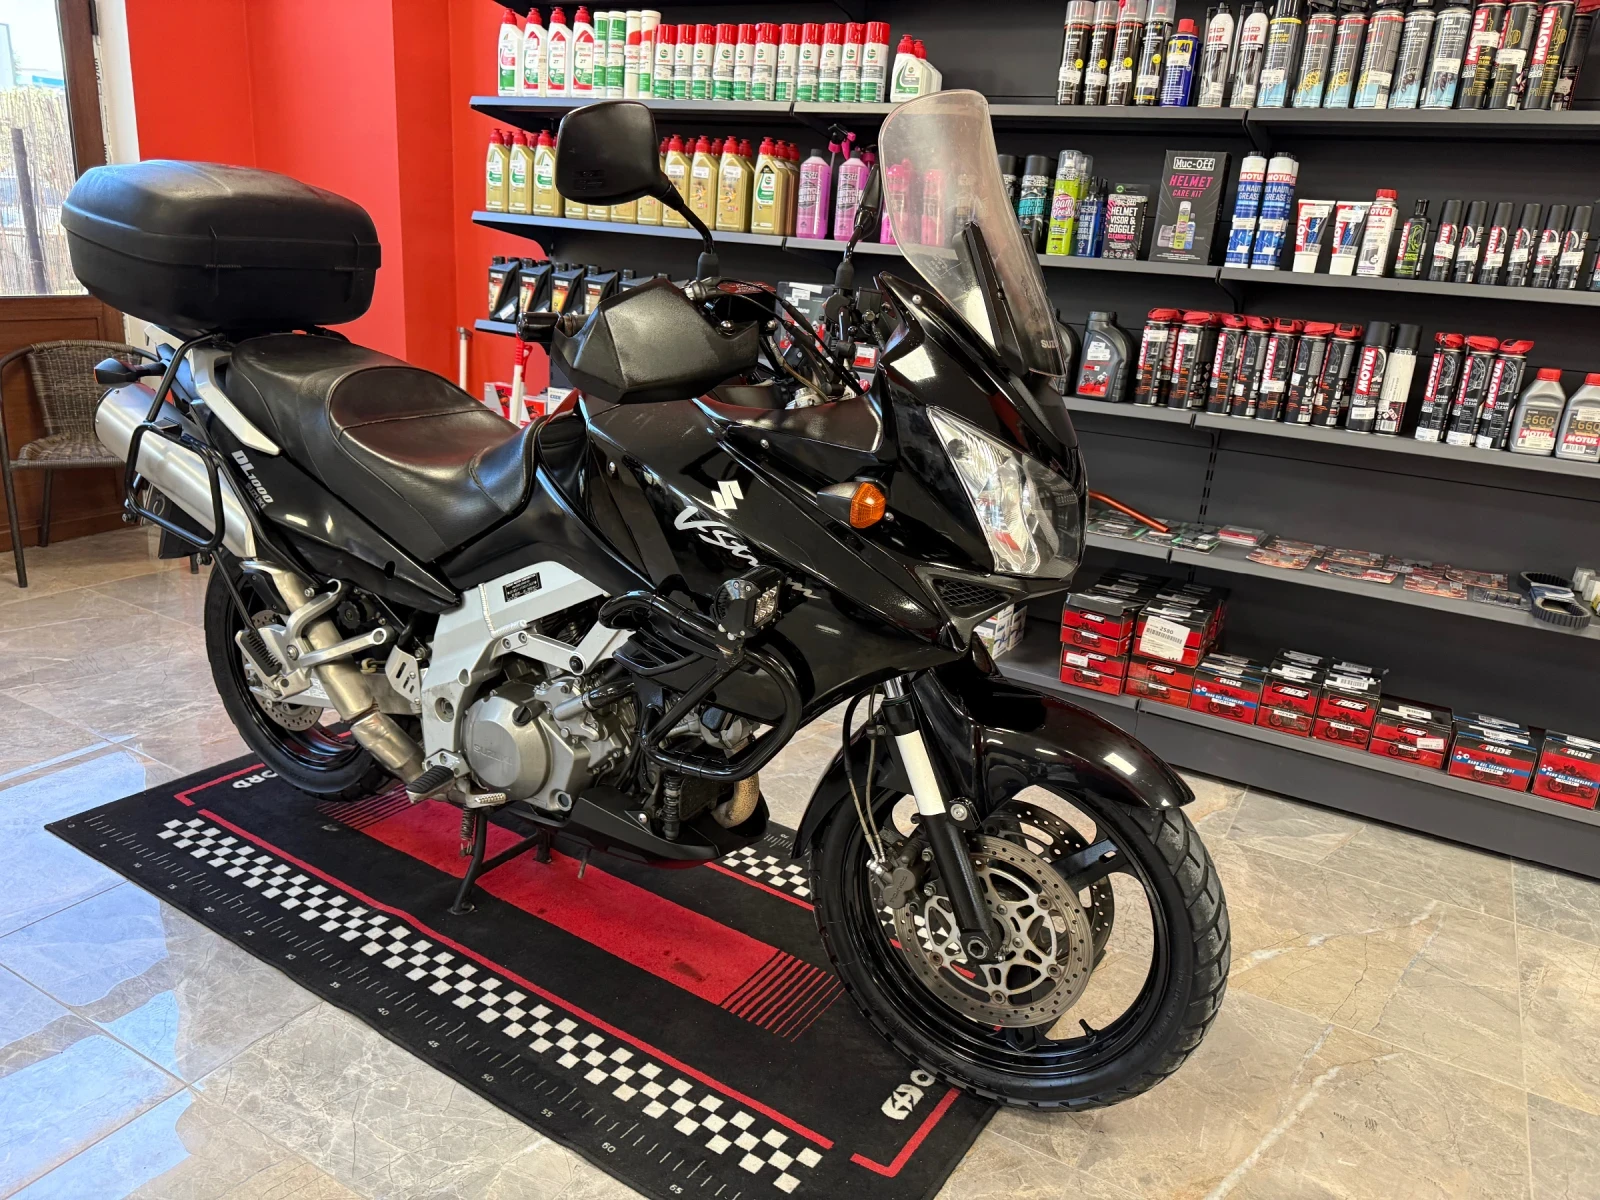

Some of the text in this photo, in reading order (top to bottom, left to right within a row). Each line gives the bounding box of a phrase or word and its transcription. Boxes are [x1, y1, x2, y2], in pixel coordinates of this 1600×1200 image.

[1534, 10, 1555, 61] MOTUL
[1175, 159, 1213, 169] Muc-Off
[1169, 175, 1213, 188] HELMET
[1191, 190, 1202, 198] KIT
[1239, 192, 1259, 200] GREASE
[1265, 193, 1286, 202] GREASE
[1111, 207, 1138, 216] HELMET
[1370, 208, 1391, 216] OTUL
[1110, 216, 1129, 224] VISOR
[1108, 224, 1135, 234] GOGGLE
[1398, 224, 1409, 257] MOTUL
[1164, 329, 1178, 366] MOTUL
[1213, 334, 1225, 374] MOTUL
[1263, 340, 1277, 380] MOTUL
[1357, 350, 1376, 392] MOTUL
[1486, 362, 1503, 406] MOTUL
[1532, 416, 1554, 425] 660
[1578, 422, 1600, 432] 660
[1521, 430, 1551, 438] MOTUL
[1566, 435, 1598, 444] MOTUL
[231, 450, 274, 503] DL1000
[246, 482, 266, 510] SUZUKI
[674, 505, 760, 567] V-Str
[1478, 744, 1513, 755] 4RIDE
[1560, 748, 1593, 759] 4RIDE
[1488, 764, 1515, 774] TECHNOLOGY
[1566, 776, 1594, 786] TECHNOLOGY
[377, 1007, 389, 1016] 40
[427, 1039, 440, 1048] 45
[480, 1074, 494, 1083] 50
[540, 1108, 554, 1118] 55
[601, 1142, 616, 1153] 60
[669, 1184, 684, 1194] 65
